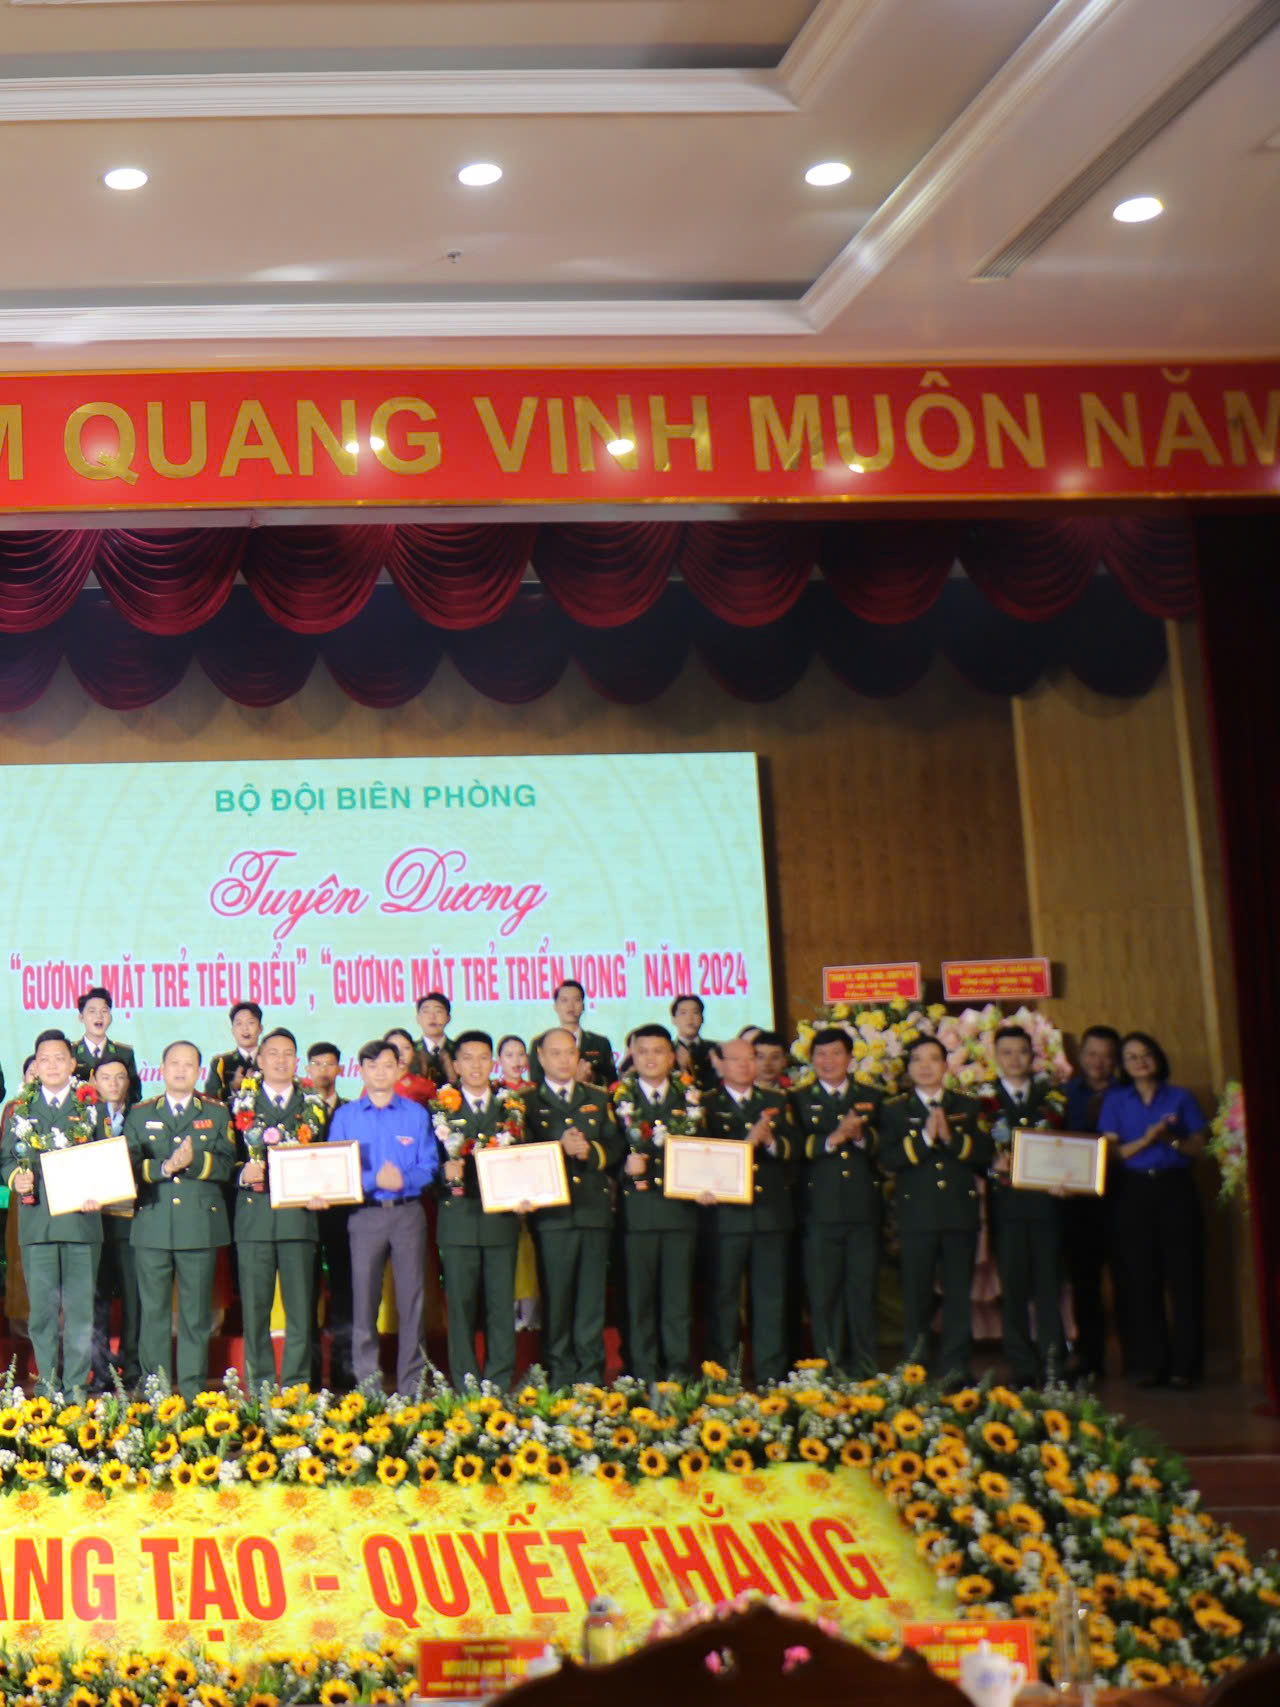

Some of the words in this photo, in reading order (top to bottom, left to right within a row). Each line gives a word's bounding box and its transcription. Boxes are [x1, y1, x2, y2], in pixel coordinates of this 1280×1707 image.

[64, 396, 442, 485] QUANG
[473, 395, 713, 475] VINH
[749, 371, 1047, 474] MUÔN
[1079, 367, 1280, 468] NĂM
[215, 783, 261, 817] BỘ
[271, 782, 325, 816] ĐỘI
[337, 780, 410, 810] BIÊN
[423, 779, 536, 809] PHÒNG
[210, 850, 369, 940] Tuyên
[380, 847, 548, 937] Dương
[152, 947, 191, 1008] TRẺ
[196, 953, 241, 1007] TIÊU
[461, 941, 499, 1001] TRẺ
[505, 936, 565, 1000] TRIỂN
[644, 944, 693, 997] NĂM
[698, 951, 748, 996] 2024
[140, 1535, 287, 1642] TẠO
[363, 1502, 599, 1629] QUYẾT
[609, 1491, 891, 1609] THẮNG
